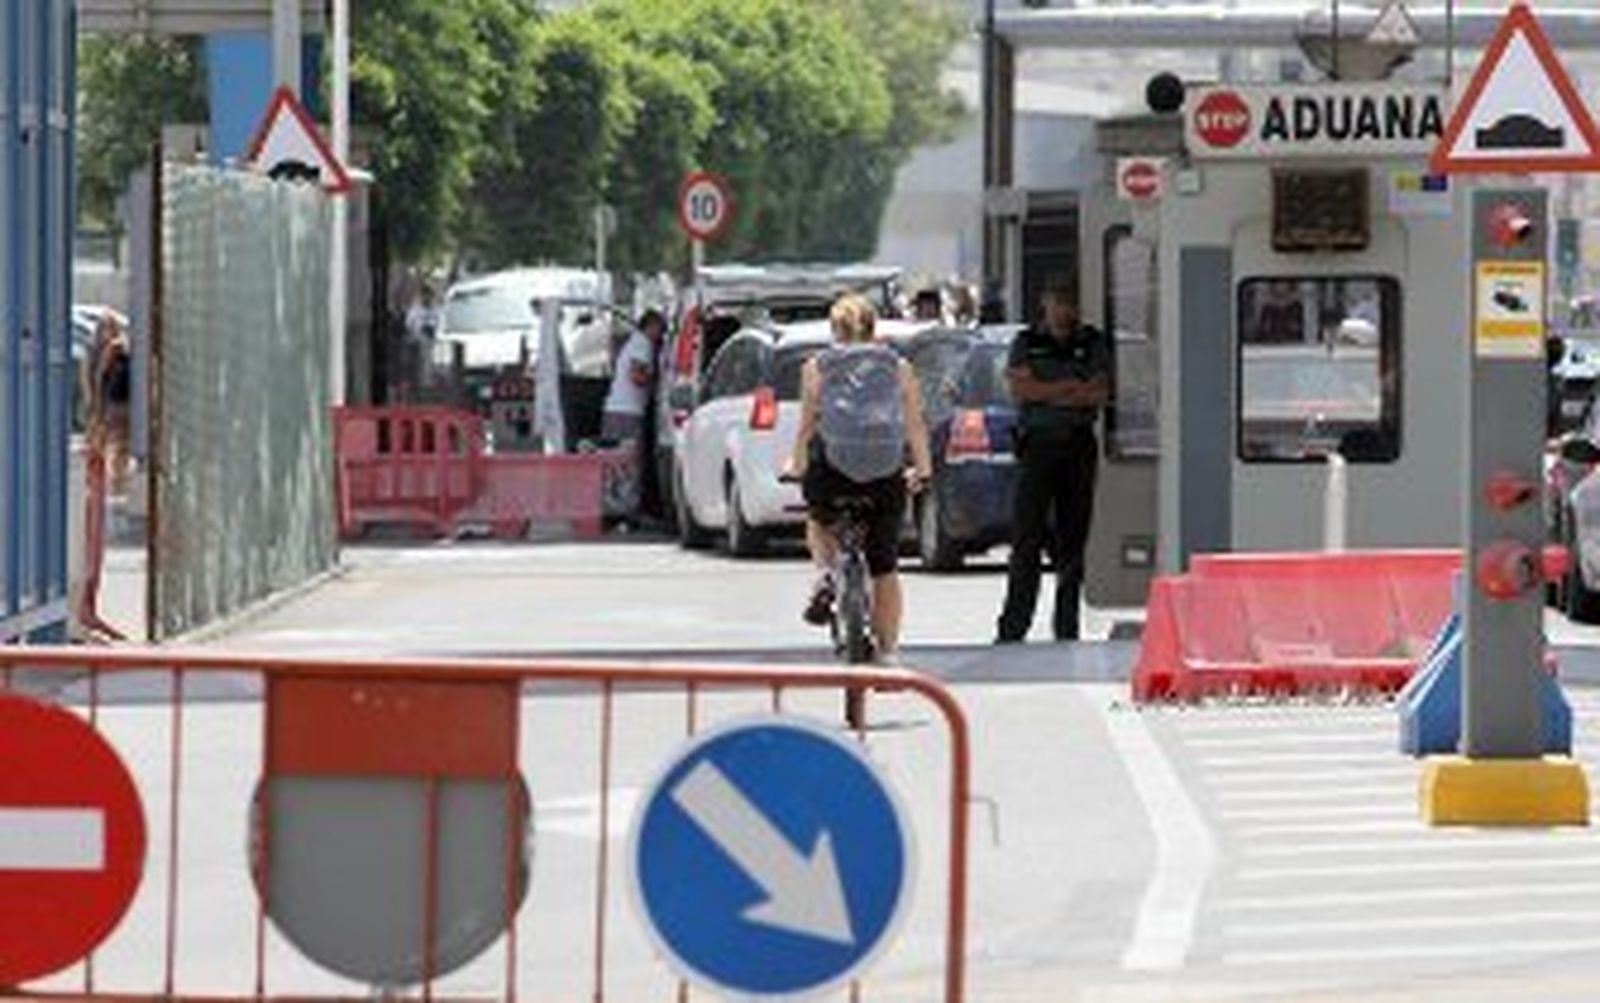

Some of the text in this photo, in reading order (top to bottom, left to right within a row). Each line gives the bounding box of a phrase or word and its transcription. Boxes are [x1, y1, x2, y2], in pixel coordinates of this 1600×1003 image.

[1196, 95, 1443, 140] STOP ADUANA
[691, 192, 718, 222] 10
